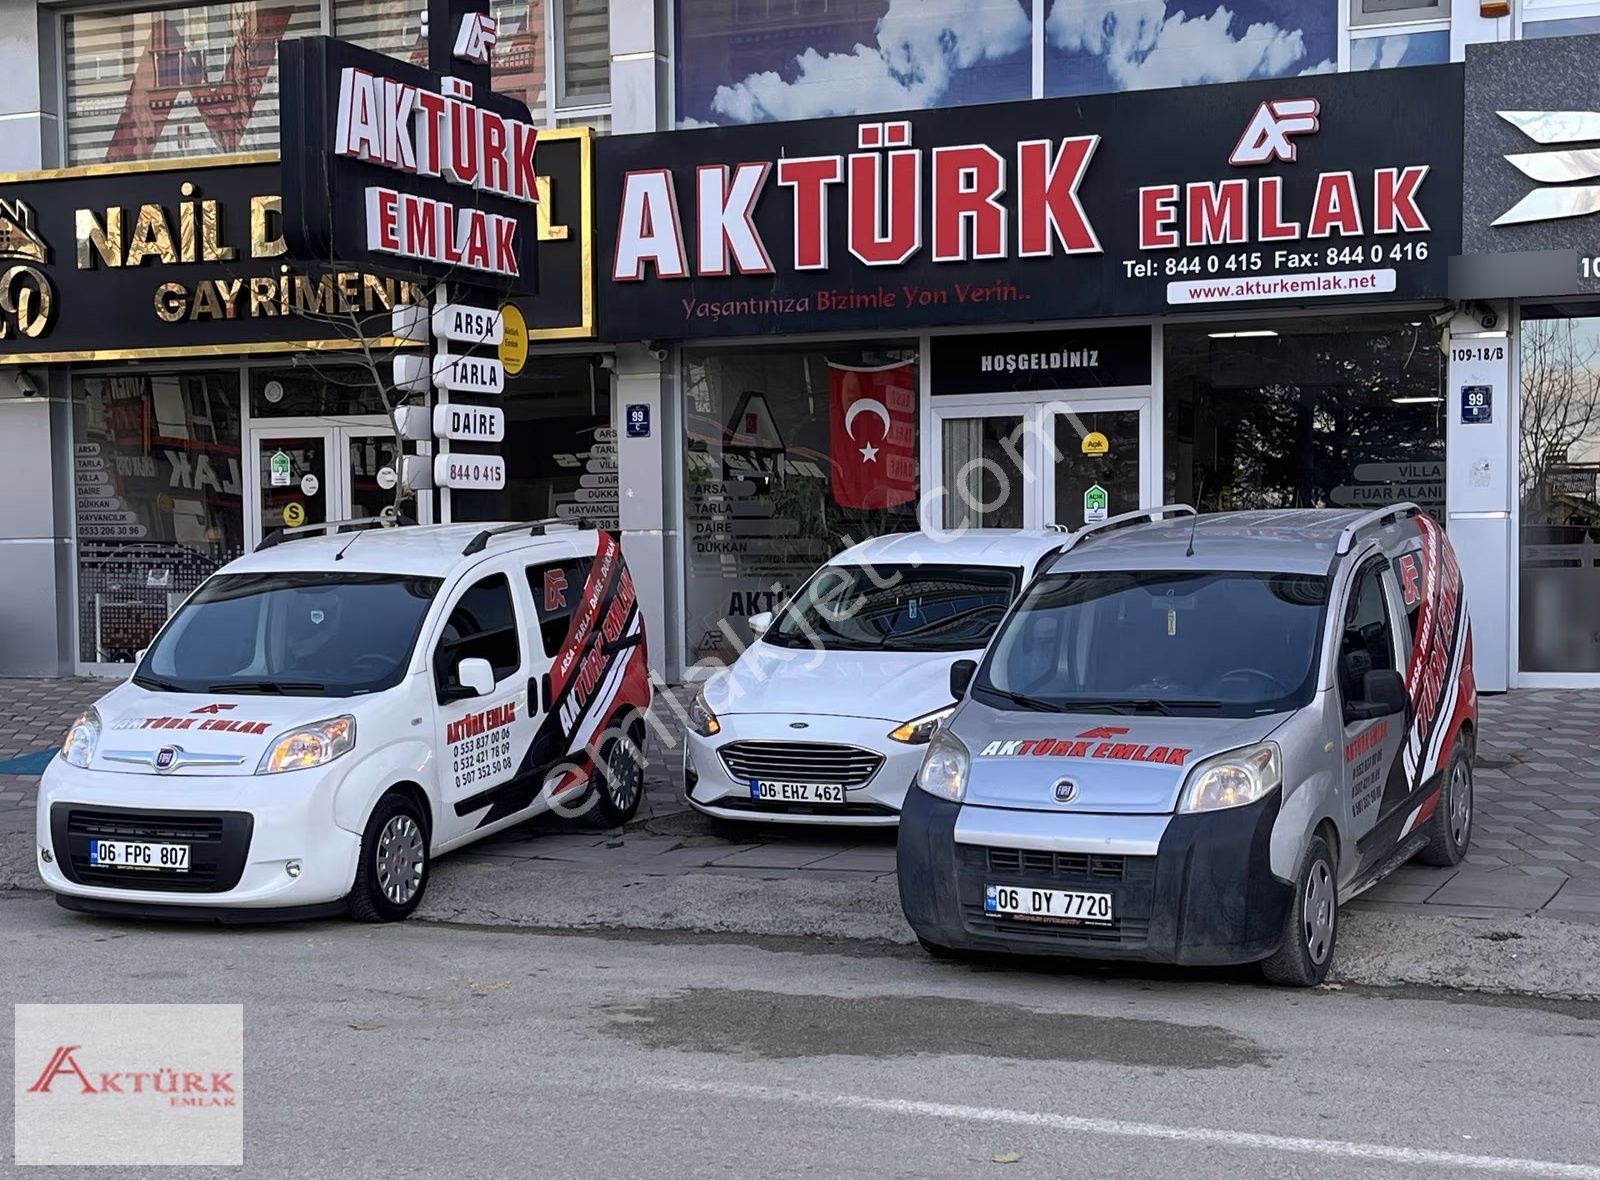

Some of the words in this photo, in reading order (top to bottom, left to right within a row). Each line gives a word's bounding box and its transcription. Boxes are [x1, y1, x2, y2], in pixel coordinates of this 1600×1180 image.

[335, 67, 540, 204] AKTÜRK
[612, 120, 1104, 282] AKTÜRK
[1138, 164, 1432, 250] EMLAK
[76, 182, 235, 270] NAİL
[365, 187, 520, 277] EMLAK
[1123, 257, 1159, 278] Tel:
[1164, 256, 1202, 276] 844
[1207, 255, 1219, 274] 0
[1224, 252, 1262, 272] 415
[1273, 249, 1320, 270] Fax:
[1326, 246, 1364, 265] 844
[1371, 245, 1383, 264] 0
[1389, 242, 1429, 263] 416
[154, 264, 428, 323] GAYRİMENK
[1188, 273, 1377, 299] www.akturkemlak.net
[681, 295, 810, 322] Yaşantınıza
[816, 288, 896, 310] Bizimle
[903, 284, 949, 308] Yön
[454, 311, 495, 338] ARSA
[981, 348, 1099, 373] HOŞGELDİNİZ
[1452, 347, 1504, 362] 109-18/B
[451, 361, 498, 387] TARLA
[1469, 393, 1484, 406] 99
[452, 408, 496, 436] DAİRE
[632, 410, 644, 422] 99
[600, 429, 618, 438] ARS
[595, 445, 618, 454] TARL
[450, 464, 470, 481] 844
[474, 464, 480, 481] 0
[483, 464, 502, 481] 415
[600, 460, 618, 469] VİLL
[1399, 463, 1442, 477] VİLLA
[598, 474, 619, 484] DAİR
[694, 484, 728, 494] ARSA
[588, 489, 619, 498] DÜKKA
[1353, 487, 1392, 500] FUAR
[1397, 487, 1442, 499] ALANI
[568, 505, 619, 514] HAYVANCILI
[694, 503, 733, 514] TARLA
[79, 526, 98, 536] 0533
[101, 526, 117, 535] 206
[128, 526, 139, 535] 96
[696, 522, 733, 533] DAİRE
[696, 541, 748, 553] DÜKKAN
[113, 716, 198, 730] AKTÜRK
[197, 718, 272, 735] EMLAK
[447, 713, 486, 745] AKTÜRK
[486, 702, 516, 731] EMLAK
[454, 745, 459, 757] 0
[461, 740, 474, 755] 553
[476, 734, 489, 749] 837
[491, 731, 500, 743] 00
[501, 727, 510, 739] 06
[979, 738, 1092, 758] AKTÜRK
[1091, 742, 1192, 766] EMLAK
[454, 760, 459, 772] 0
[461, 755, 475, 770] 532
[476, 750, 488, 764] 421
[491, 745, 500, 758] 78
[501, 742, 510, 755] 09
[456, 776, 460, 788] 0
[462, 770, 475, 786] 507
[478, 764, 491, 779] 352
[493, 760, 501, 774] 50
[503, 756, 512, 769] 08
[759, 782, 777, 798] 06
[782, 784, 809, 800] EHZ
[814, 785, 842, 801] 462
[99, 843, 117, 862] 06
[125, 844, 152, 864] FPG
[160, 846, 188, 867] 807
[998, 888, 1020, 910] 06
[1032, 891, 1053, 912] DY
[1063, 892, 1108, 917] 7720
